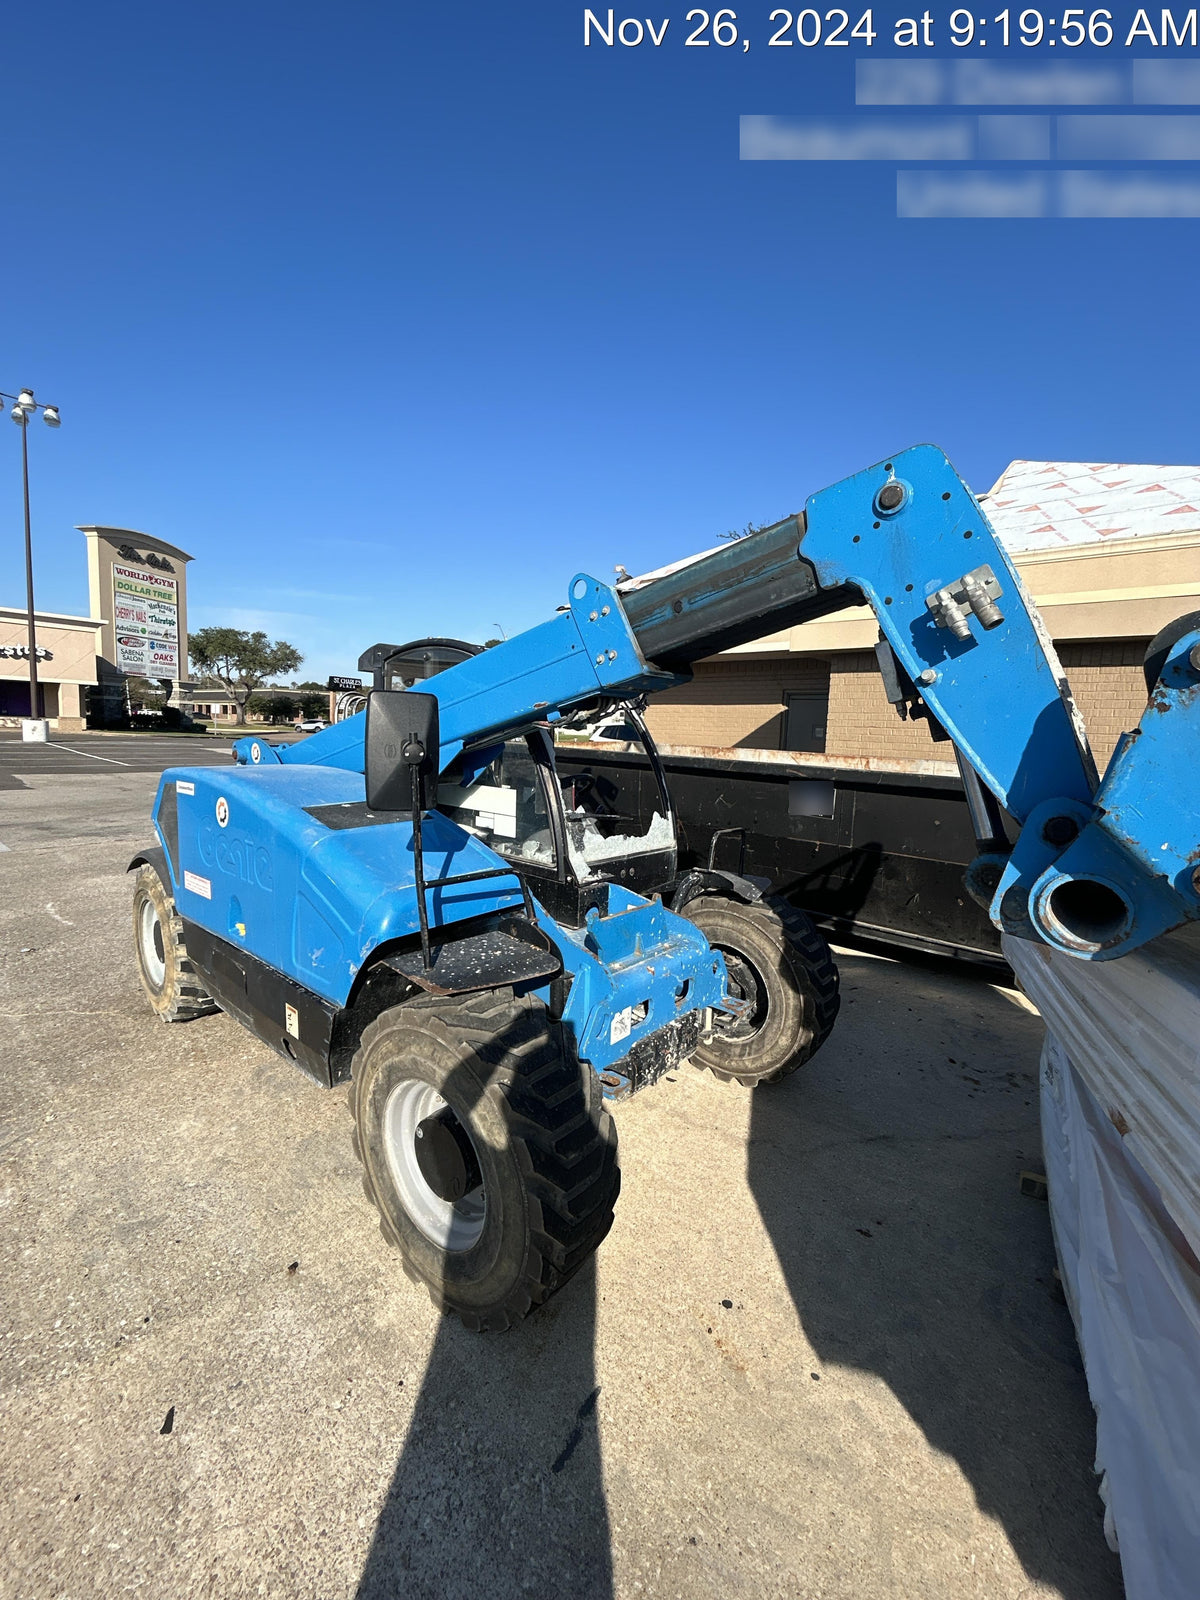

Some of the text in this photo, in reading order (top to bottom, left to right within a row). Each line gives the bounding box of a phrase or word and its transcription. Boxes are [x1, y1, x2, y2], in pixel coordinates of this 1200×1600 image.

[115, 567, 175, 589] WORLD GYM
[117, 581, 173, 601] DOLLAR TREE
[153, 653, 174, 662] OAKS
